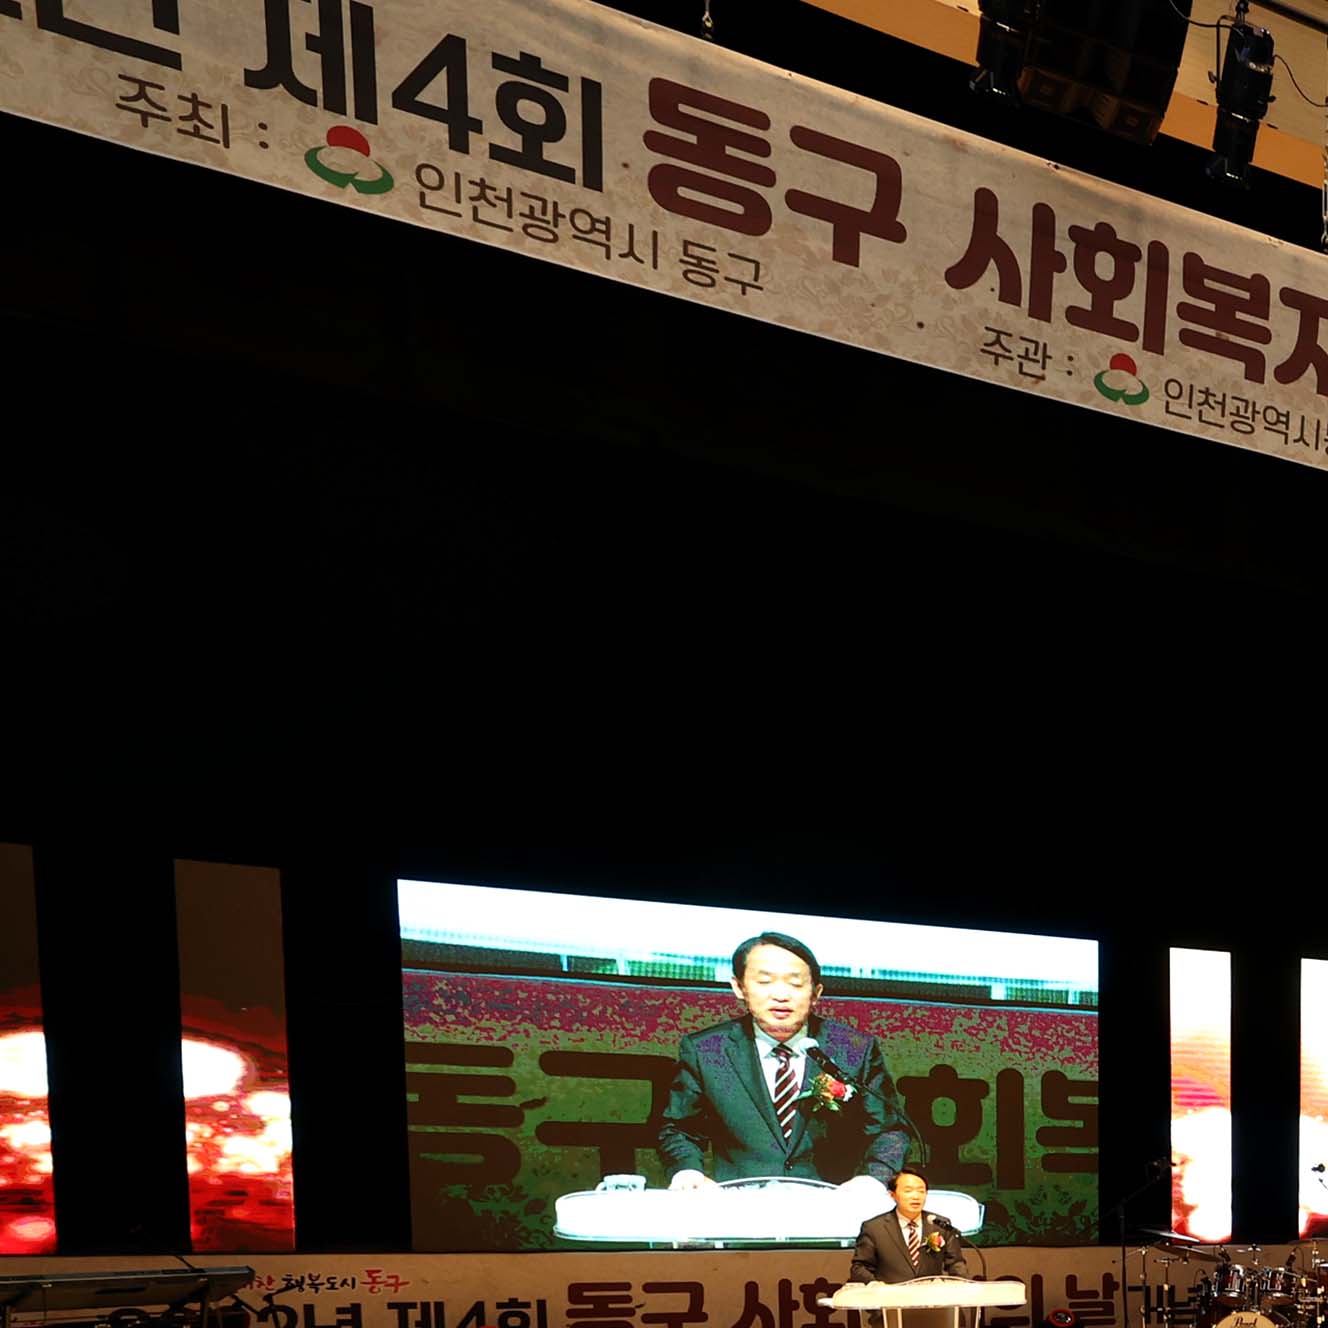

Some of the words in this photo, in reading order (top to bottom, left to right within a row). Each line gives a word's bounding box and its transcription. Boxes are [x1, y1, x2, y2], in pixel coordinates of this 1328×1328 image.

[244, 0, 604, 193] 제4회
[645, 76, 908, 268] 동구
[115, 73, 231, 149] 주최
[413, 161, 661, 272] 인천광역시
[677, 239, 765, 297] 동구
[979, 326, 1053, 384] 주관
[360, 1269, 410, 1294] 동구
[1065, 1272, 1120, 1326] 날
